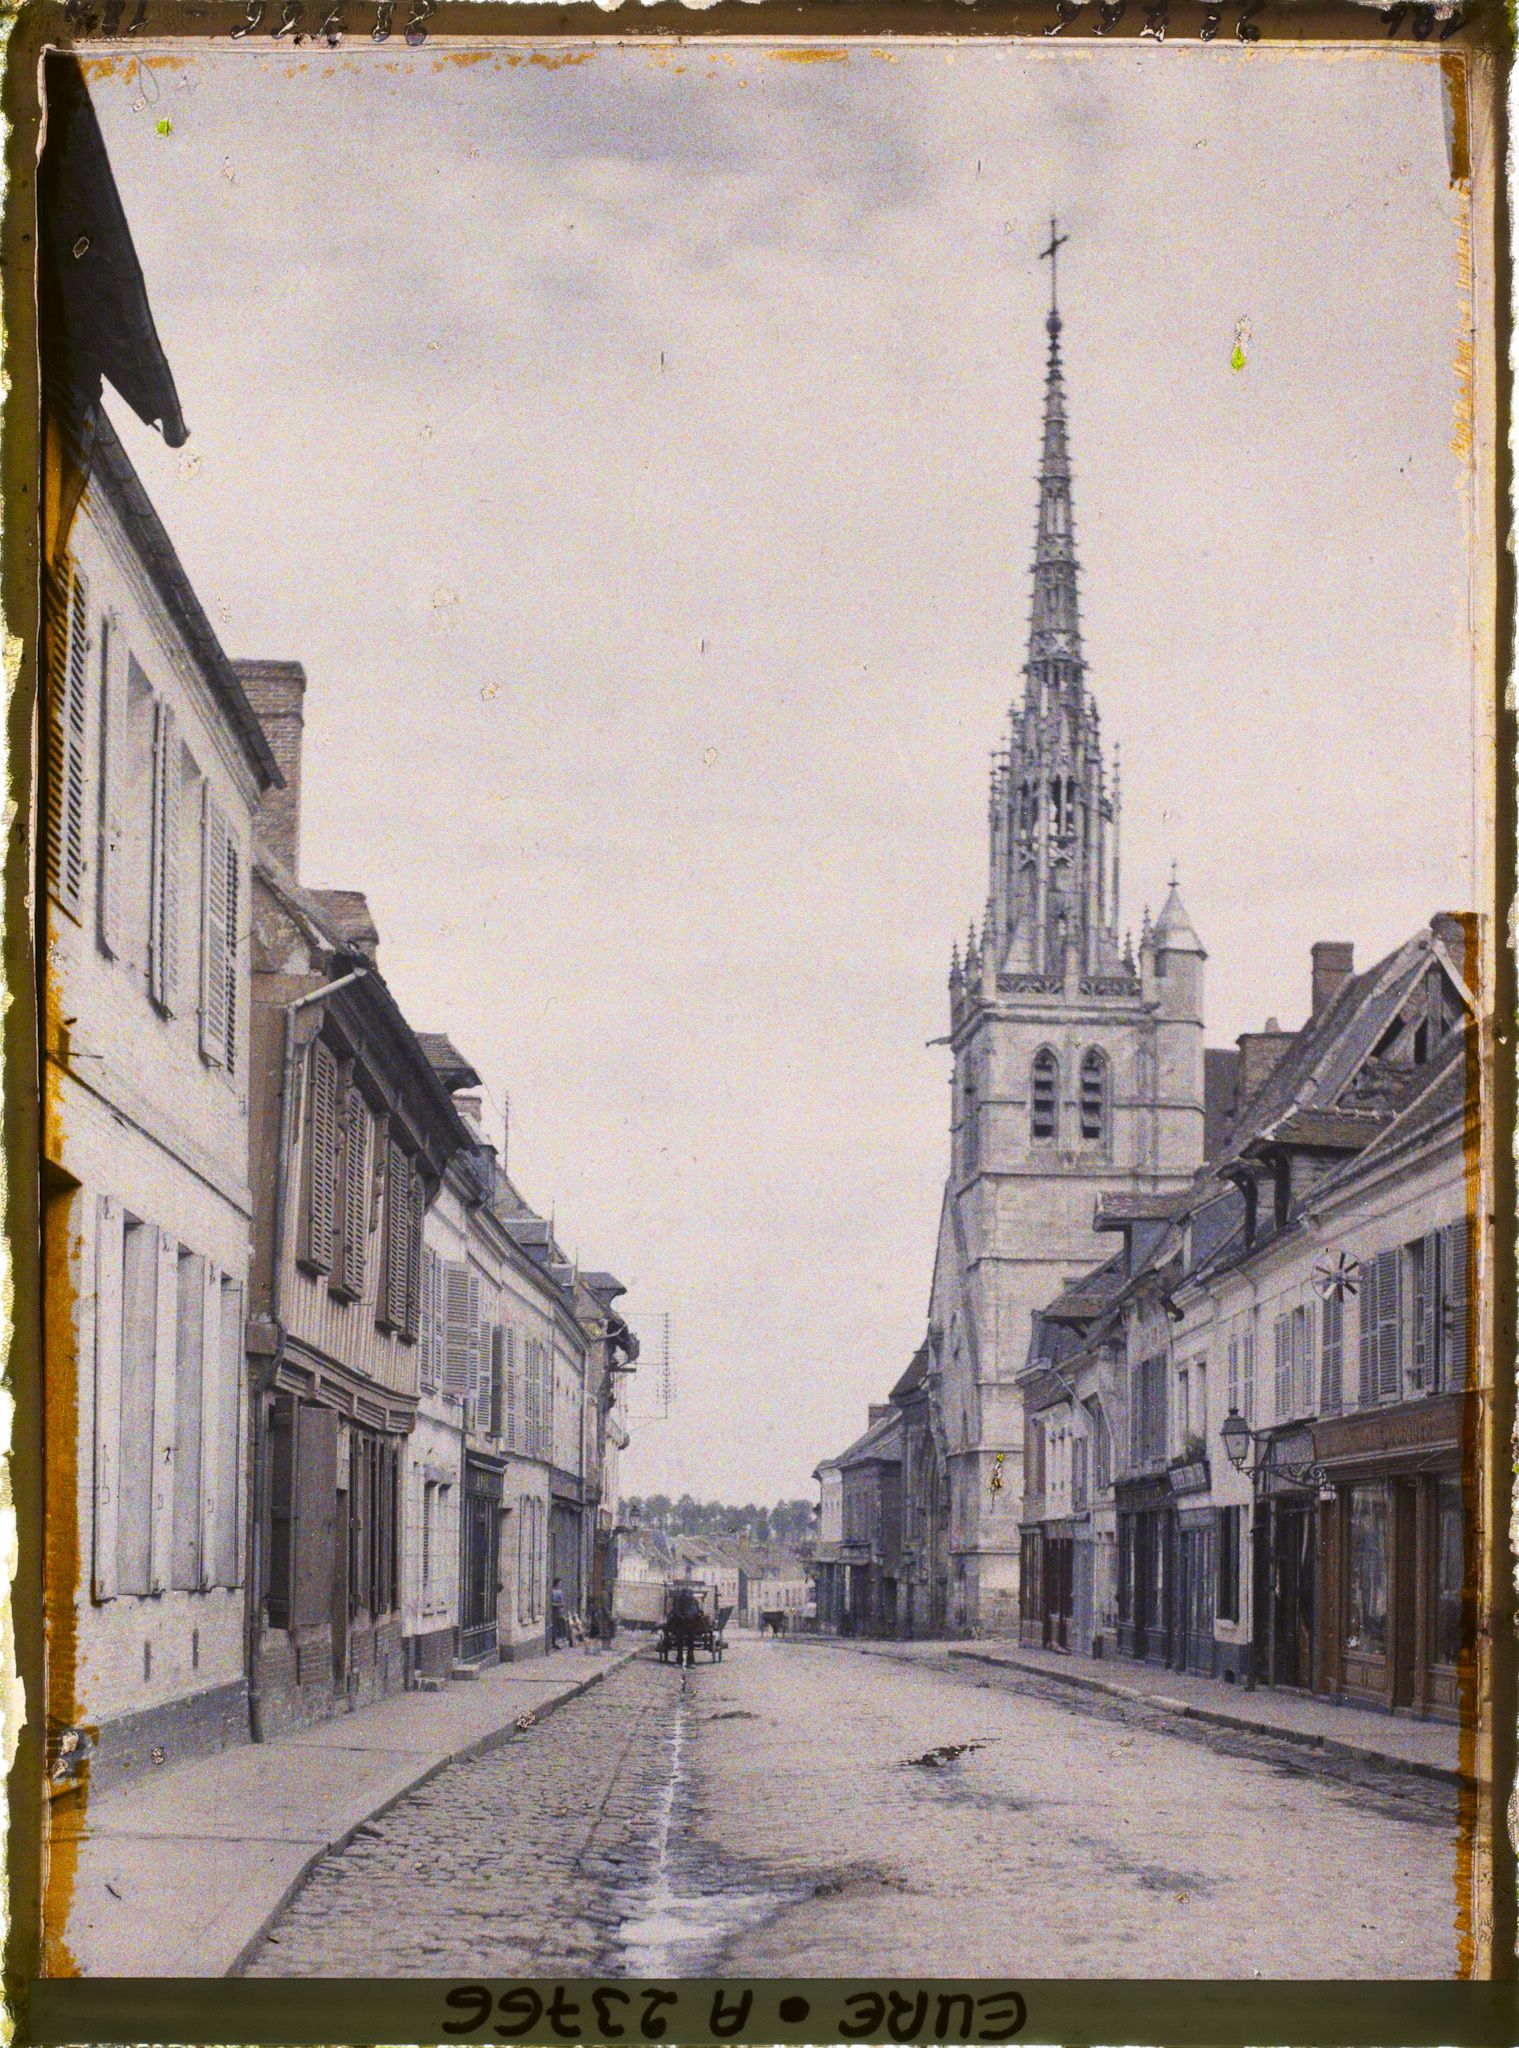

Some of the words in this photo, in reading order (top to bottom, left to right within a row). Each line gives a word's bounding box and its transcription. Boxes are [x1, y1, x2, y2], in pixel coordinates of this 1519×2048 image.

[442, 1986, 678, 2039] 23766
[709, 1988, 753, 2038] A
[838, 1990, 1027, 2042] EURE
